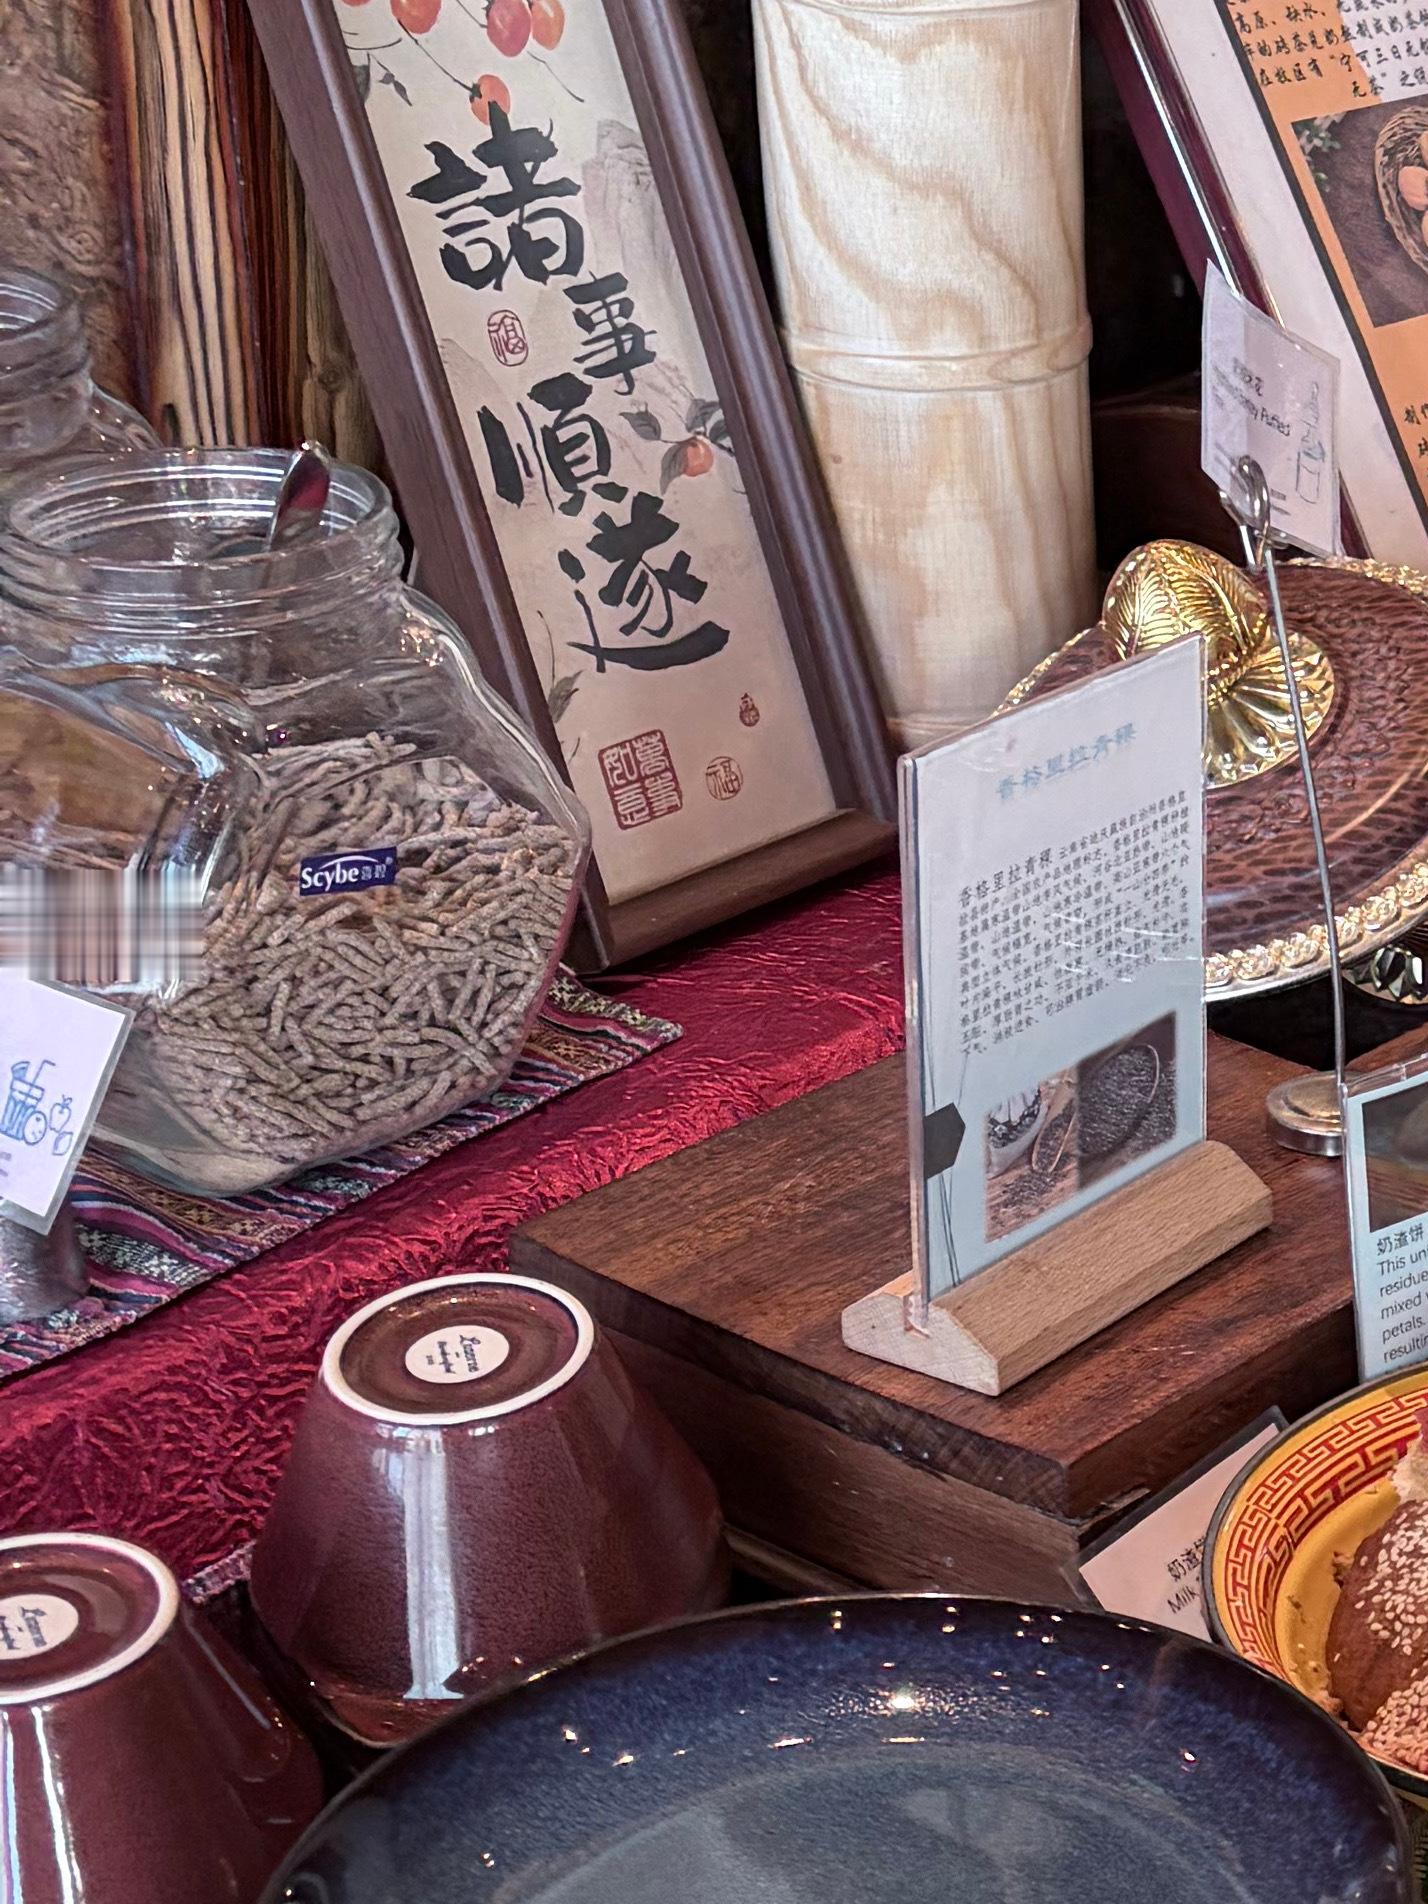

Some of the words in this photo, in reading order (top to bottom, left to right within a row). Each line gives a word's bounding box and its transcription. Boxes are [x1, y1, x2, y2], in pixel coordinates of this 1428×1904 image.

[410, 100, 731, 674] 諸事順遂
[301, 862, 360, 892] Scybe
[1377, 1222, 1425, 1256] 奶渣饼
[1377, 1254, 1406, 1278] This
[1381, 1293, 1422, 1320] mixed
[1382, 1315, 1426, 1345] petals.
[1167, 1585, 1199, 1614] Milk
